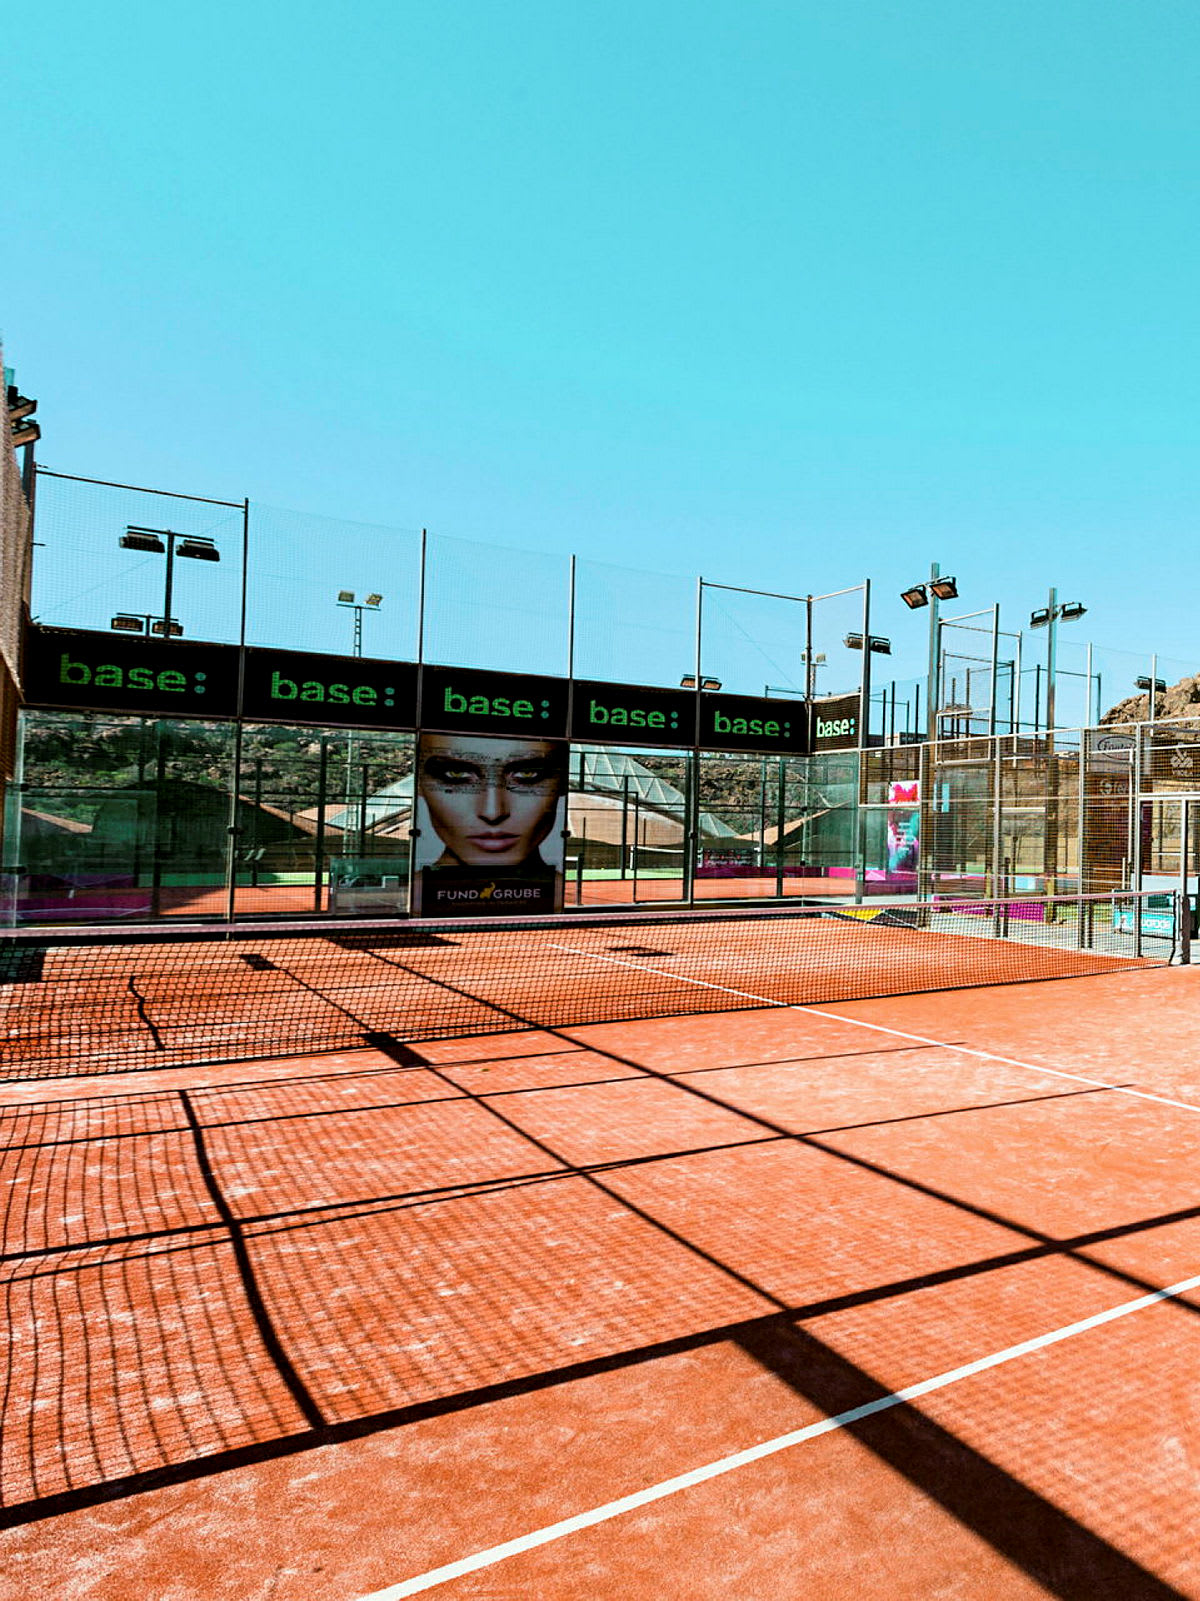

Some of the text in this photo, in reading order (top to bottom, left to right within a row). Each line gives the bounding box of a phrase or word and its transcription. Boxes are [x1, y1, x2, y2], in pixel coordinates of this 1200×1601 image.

[59, 652, 207, 694] base:
[270, 670, 395, 707] base:
[443, 687, 550, 719] base:
[589, 700, 679, 730] base:
[714, 710, 791, 738] base:
[816, 716, 857, 738] base:
[437, 888, 541, 900] FUND GRUBE
